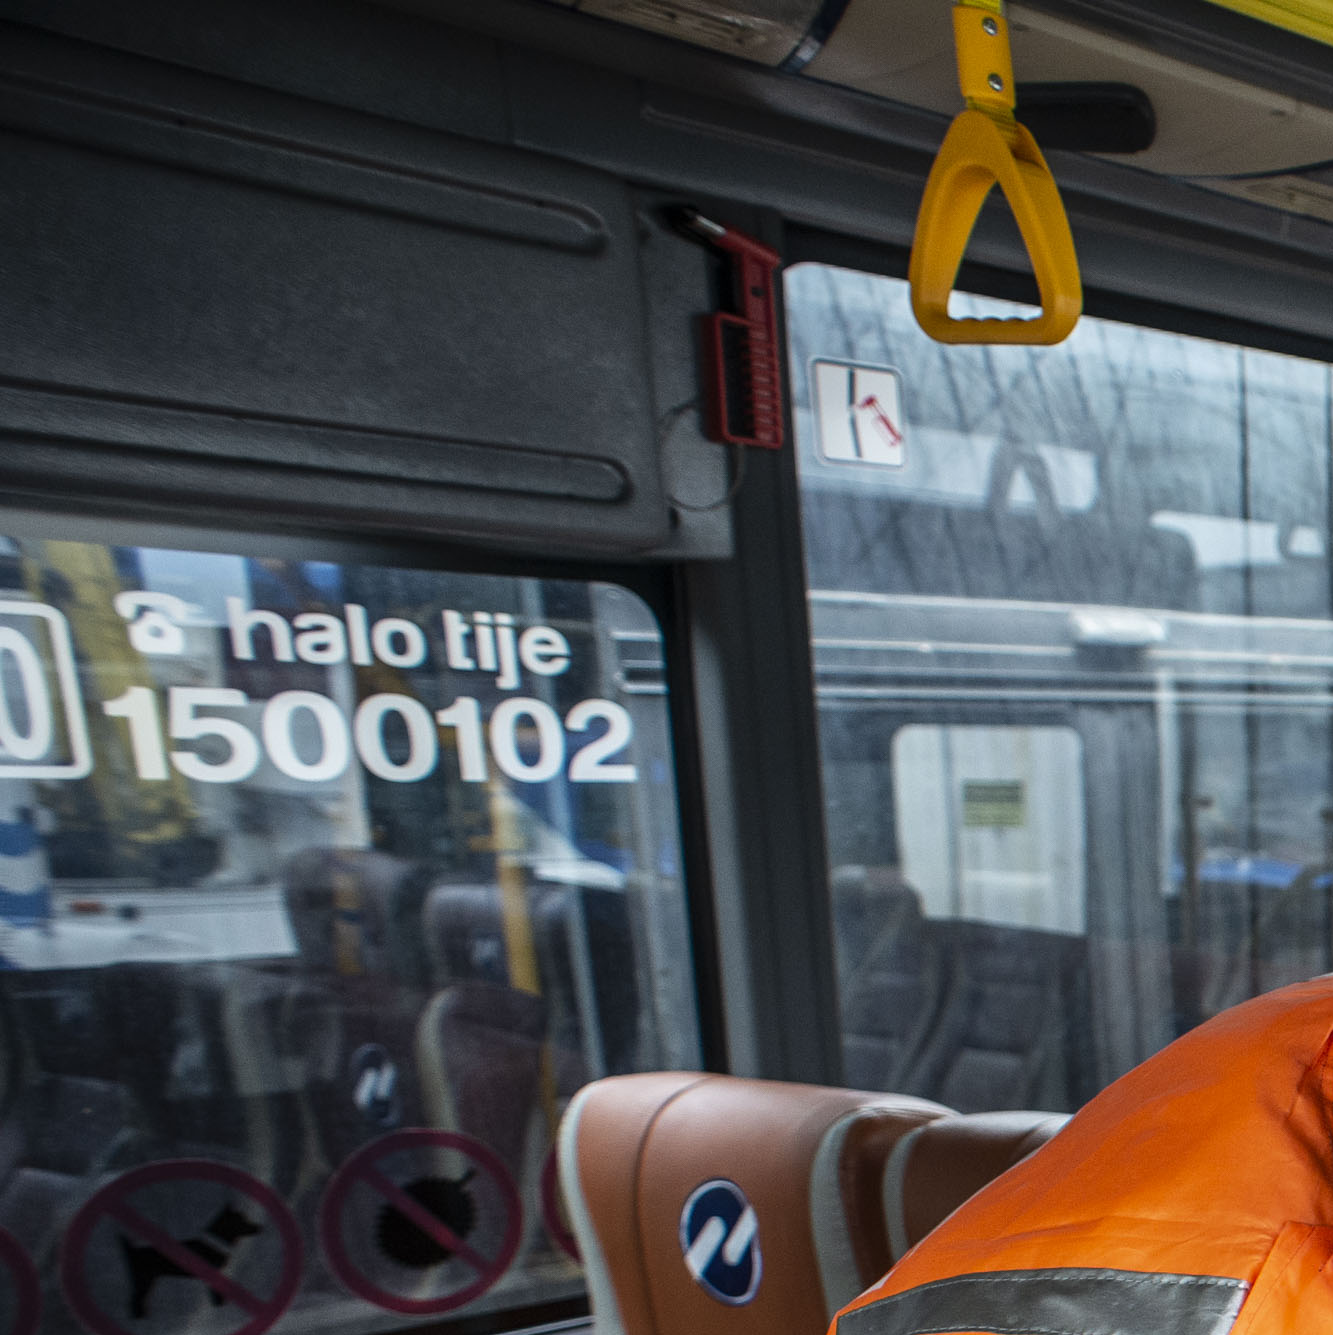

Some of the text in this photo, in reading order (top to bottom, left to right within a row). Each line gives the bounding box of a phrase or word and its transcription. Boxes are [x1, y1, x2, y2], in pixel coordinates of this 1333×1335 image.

[228, 597, 572, 689] halo tije
[103, 686, 638, 783] 1500102
